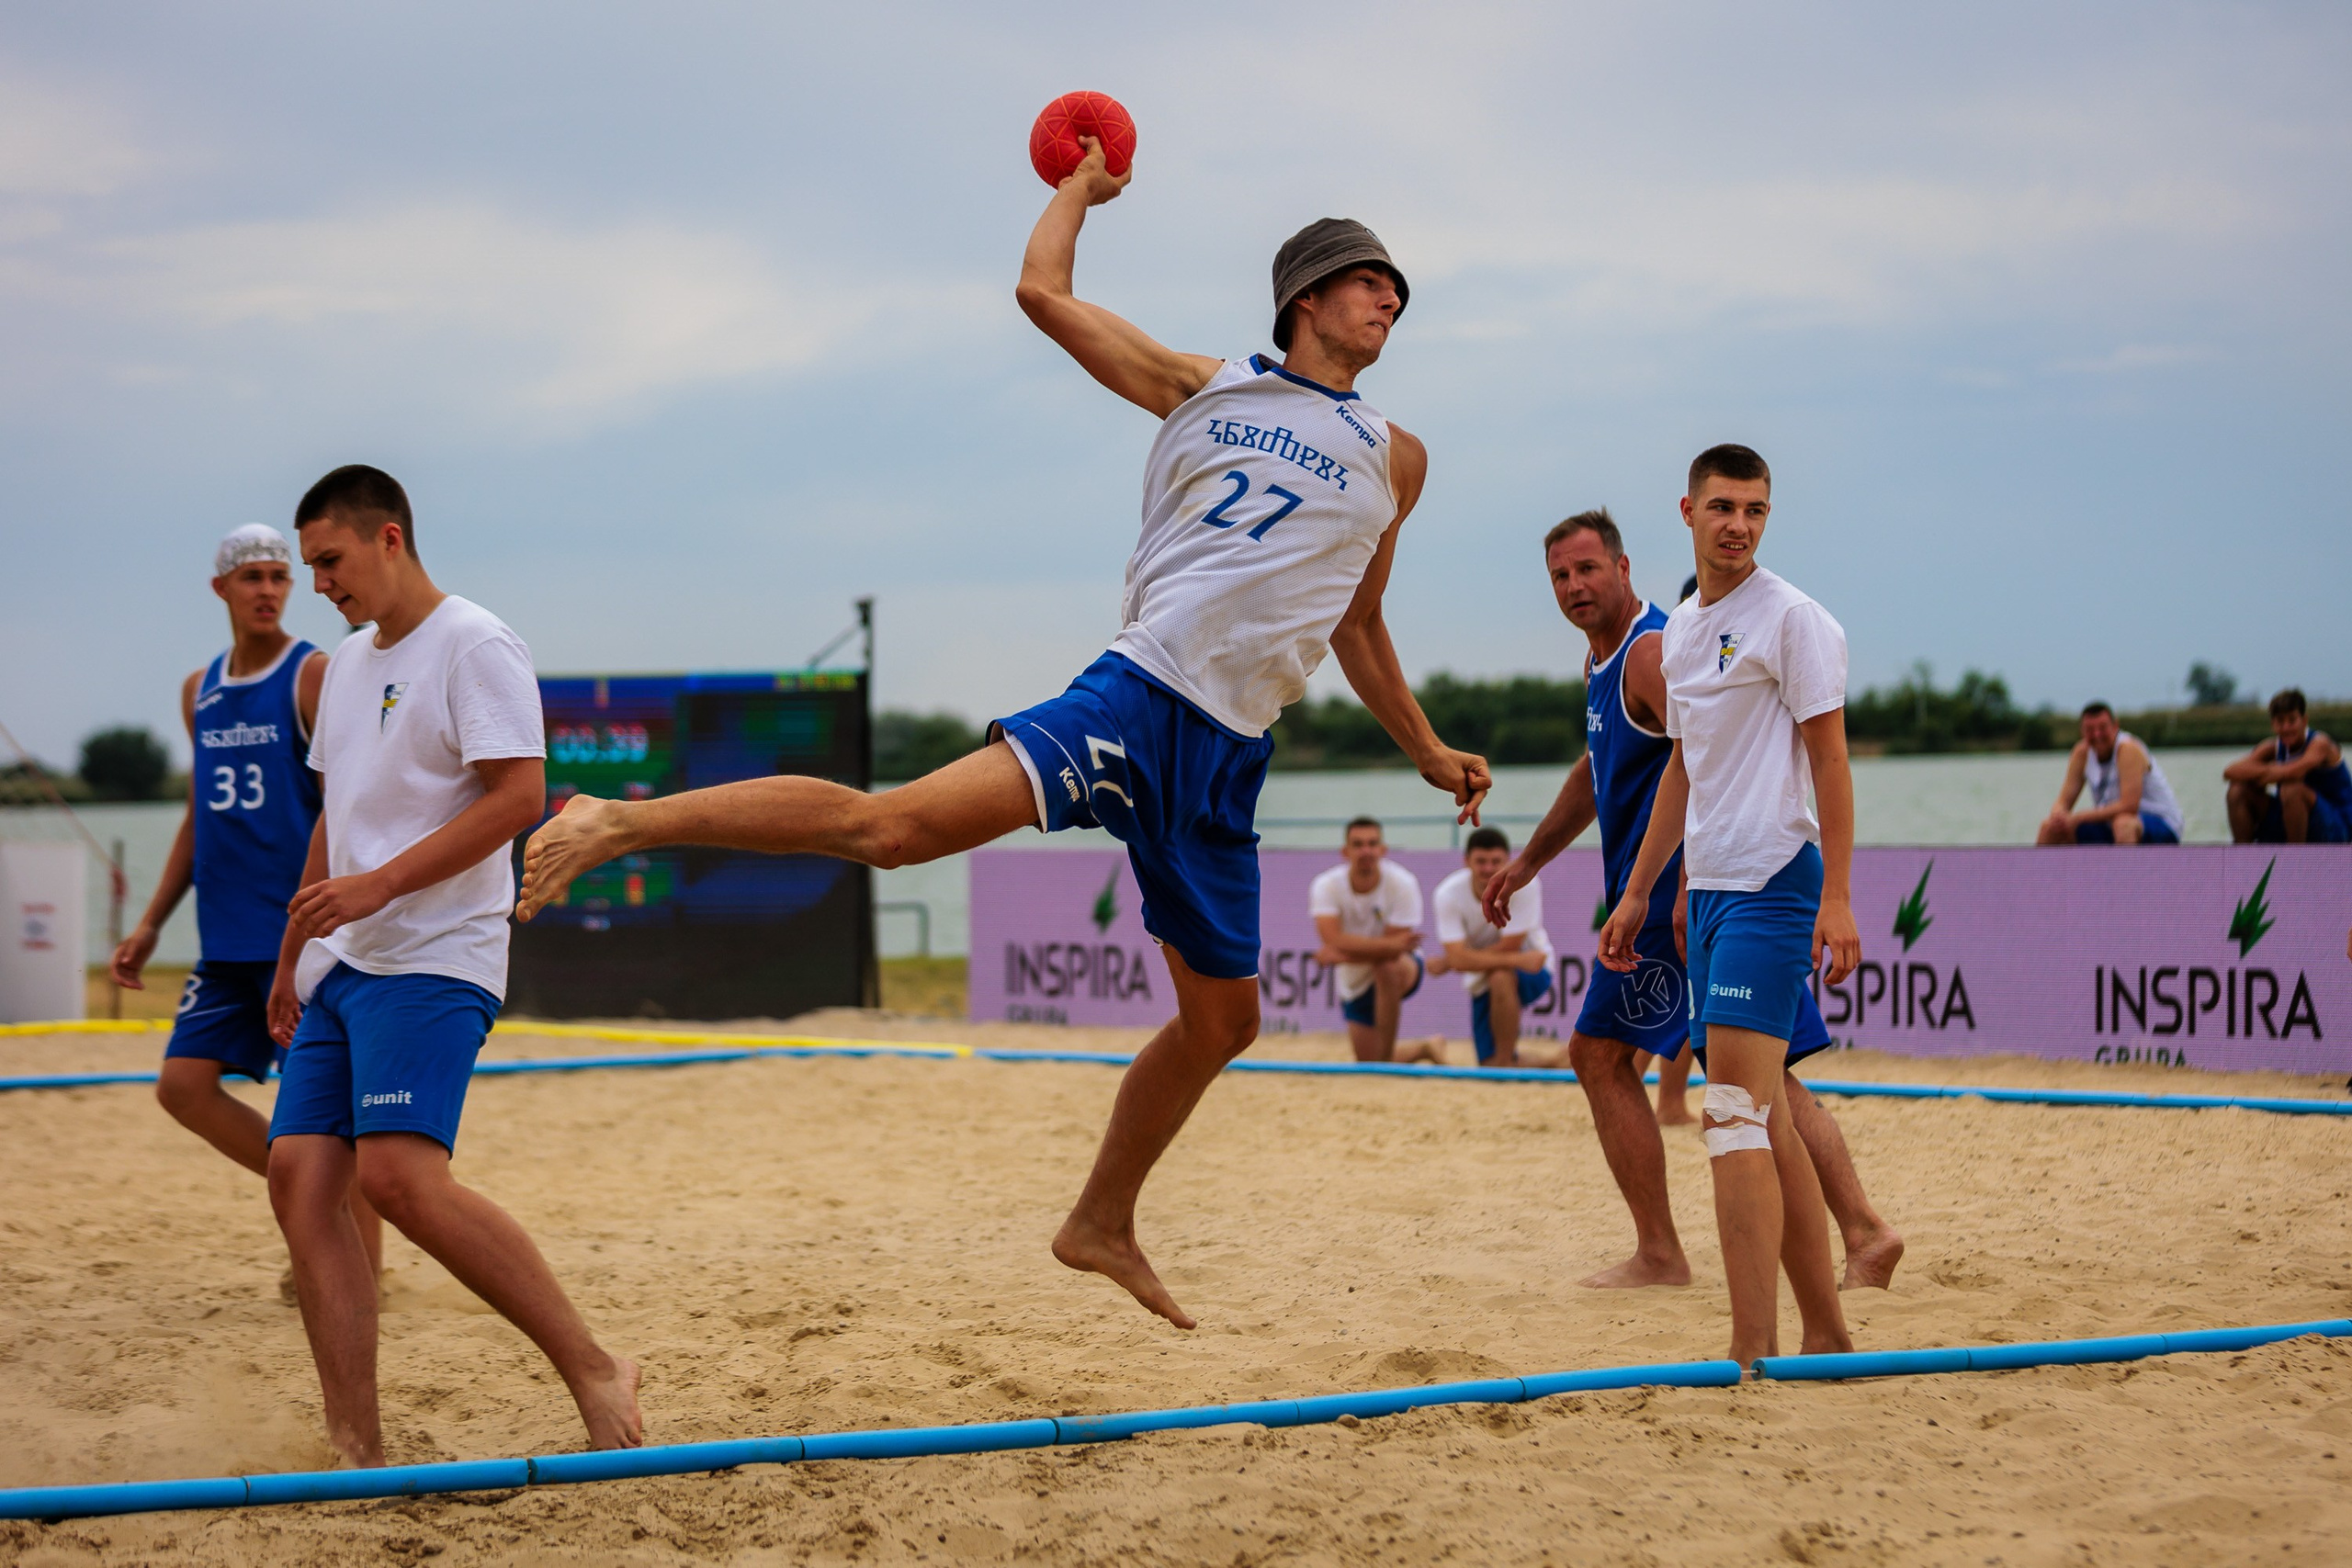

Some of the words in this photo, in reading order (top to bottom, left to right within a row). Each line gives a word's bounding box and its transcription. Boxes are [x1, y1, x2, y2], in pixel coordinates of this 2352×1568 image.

[1335, 405, 1377, 449] Kempa
[1201, 469, 1305, 544] 27
[209, 762, 266, 811] 33
[1004, 941, 1153, 1001] INSPIRA
[1718, 986, 1753, 1000] unit
[2095, 964, 2324, 1041] INSPIRA
[373, 1089, 413, 1105] unit
